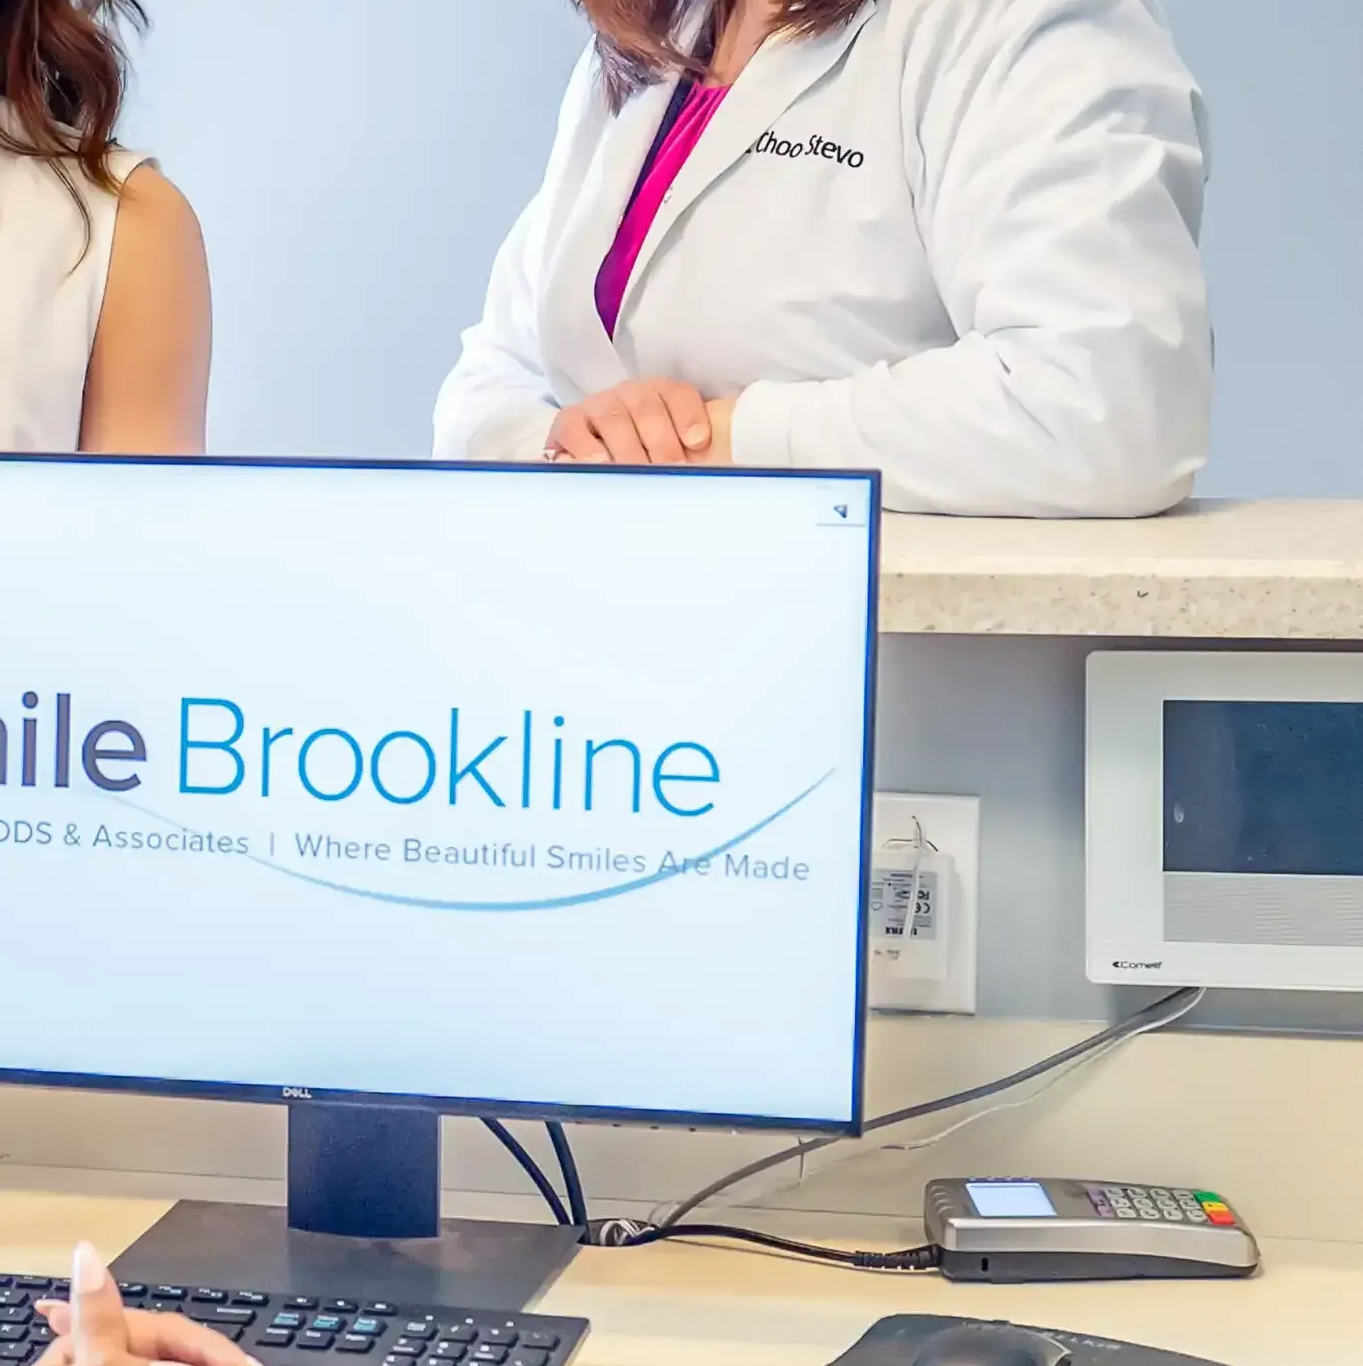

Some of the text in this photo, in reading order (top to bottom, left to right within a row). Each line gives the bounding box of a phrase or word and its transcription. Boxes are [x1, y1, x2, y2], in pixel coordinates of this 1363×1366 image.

[178, 697, 721, 818] Brookline
[63, 823, 81, 847] &
[92, 824, 249, 855] Associates
[294, 832, 392, 862] Where
[403, 837, 536, 868] Beautiful
[547, 844, 647, 874] Smiles
[658, 850, 712, 877] Are
[724, 852, 811, 882] Made
[282, 1087, 312, 1099] DELL
